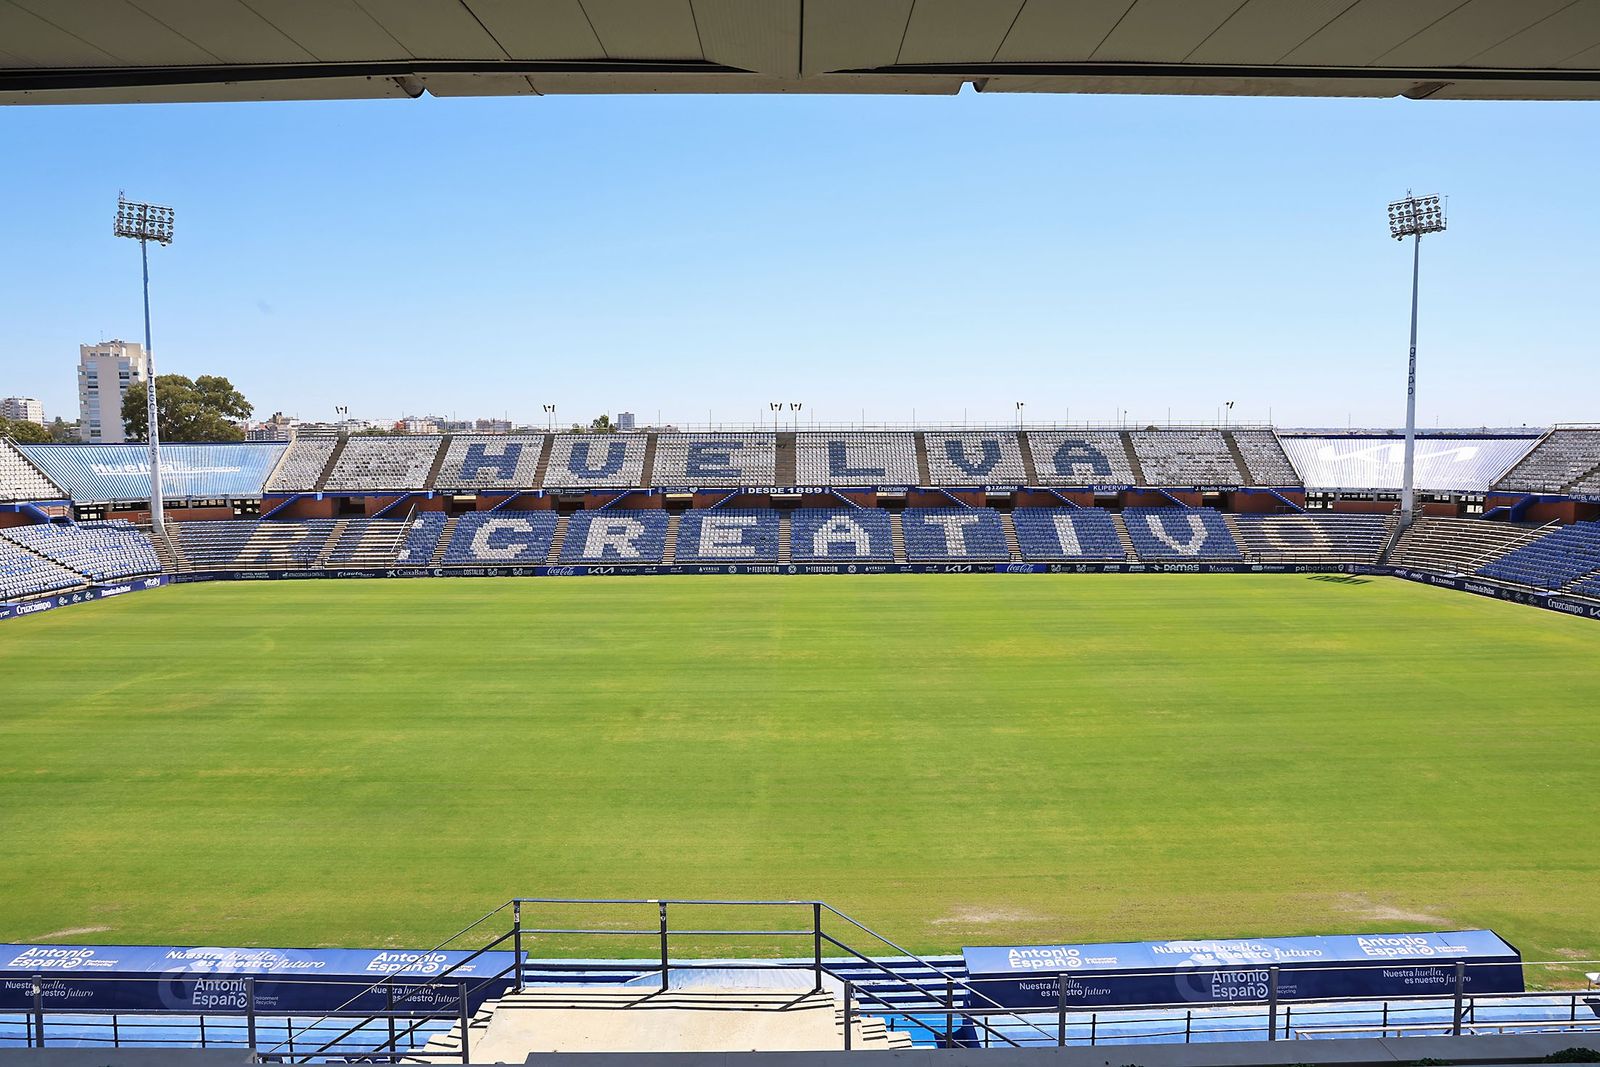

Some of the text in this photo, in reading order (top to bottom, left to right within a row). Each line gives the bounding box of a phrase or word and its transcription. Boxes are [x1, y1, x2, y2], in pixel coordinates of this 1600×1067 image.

[458, 440, 1113, 480] HUELVA
[877, 485, 909, 493] Cruzcampo
[397, 568, 430, 576] CaixaBank
[587, 566, 615, 574] KIA
[16, 601, 52, 615] Cruzcampo
[1547, 598, 1584, 614] Cruzcampo
[1357, 936, 1427, 947] Antonio
[20, 947, 94, 958] Antonio
[166, 950, 223, 960] Nuestra
[1008, 947, 1080, 959] Antonio
[1152, 945, 1210, 954] Nuestra
[1273, 948, 1323, 960] futuro
[372, 952, 447, 963] Antonio
[216, 960, 273, 968] nuestro
[272, 958, 326, 970] futuro
[1211, 971, 1269, 983] Antonio
[1383, 969, 1414, 978] Nuestra
[5, 981, 34, 989] Nuestr
[1415, 976, 1444, 984] nuestro
[1445, 974, 1471, 985] futro
[371, 986, 403, 994] Nuetra
[1019, 982, 1051, 990] Nuestra
[64, 988, 94, 999] futuro
[1051, 988, 1082, 996] nustro
[1082, 986, 1111, 998] futuro
[433, 993, 458, 1005] futur
